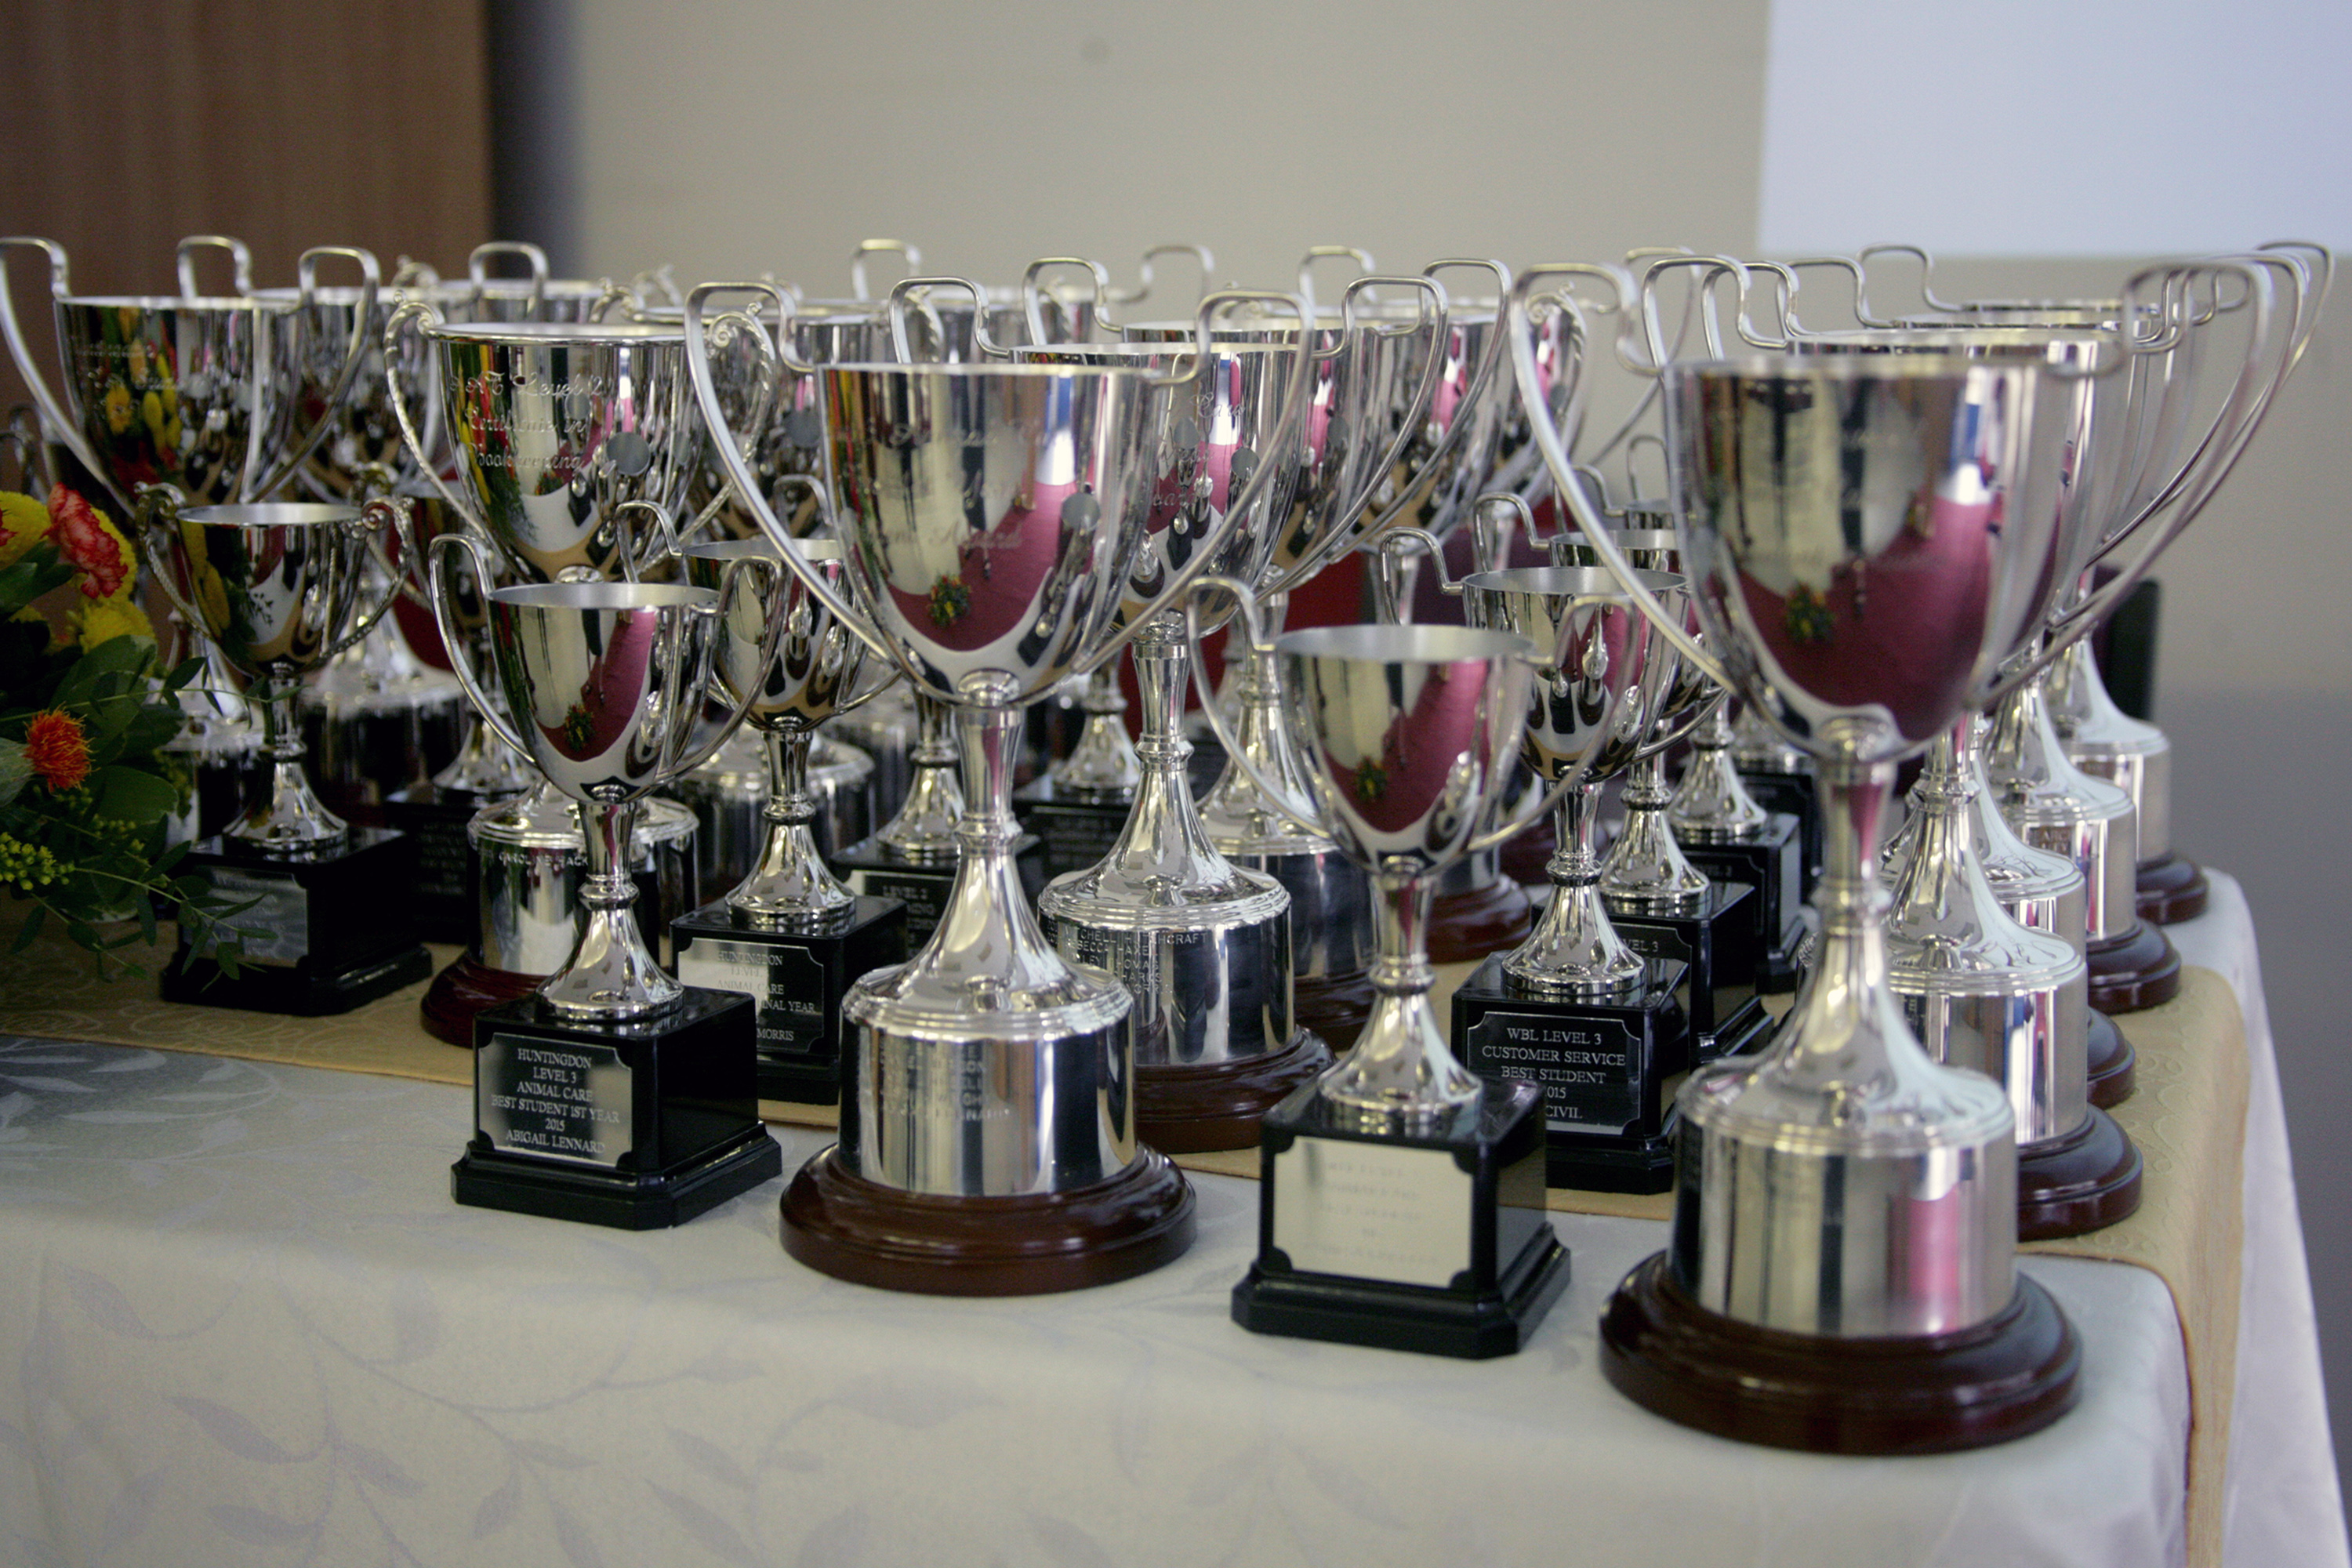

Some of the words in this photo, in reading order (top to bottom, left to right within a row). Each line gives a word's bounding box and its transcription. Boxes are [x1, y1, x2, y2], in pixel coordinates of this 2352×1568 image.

[718, 950, 782, 965] HUNTINGDON
[717, 979, 756, 992] ANIMAL
[788, 1000, 816, 1013] YEAR
[1507, 1027, 1538, 1041] WBL
[1543, 1029, 1590, 1044] LEVEL
[1594, 1033, 1601, 1044] 3
[517, 1048, 592, 1069] HUNTINGDON
[1482, 1045, 1560, 1062] CUSTOMER
[1564, 1051, 1626, 1066] SERVICE
[533, 1066, 568, 1083] LEVEL
[570, 1072, 577, 1083] 3
[1501, 1065, 1535, 1079] BEST
[1539, 1069, 1606, 1083] STUDENT
[517, 1081, 561, 1098] ANIMAL
[563, 1087, 593, 1102] CARE
[492, 1094, 517, 1109] BEST
[518, 1098, 568, 1116] STUDENT
[589, 1108, 620, 1123] YEAR
[545, 1118, 565, 1132] 2015
[506, 1130, 549, 1146] ABIGAIL
[551, 1135, 605, 1154] LENNARD
